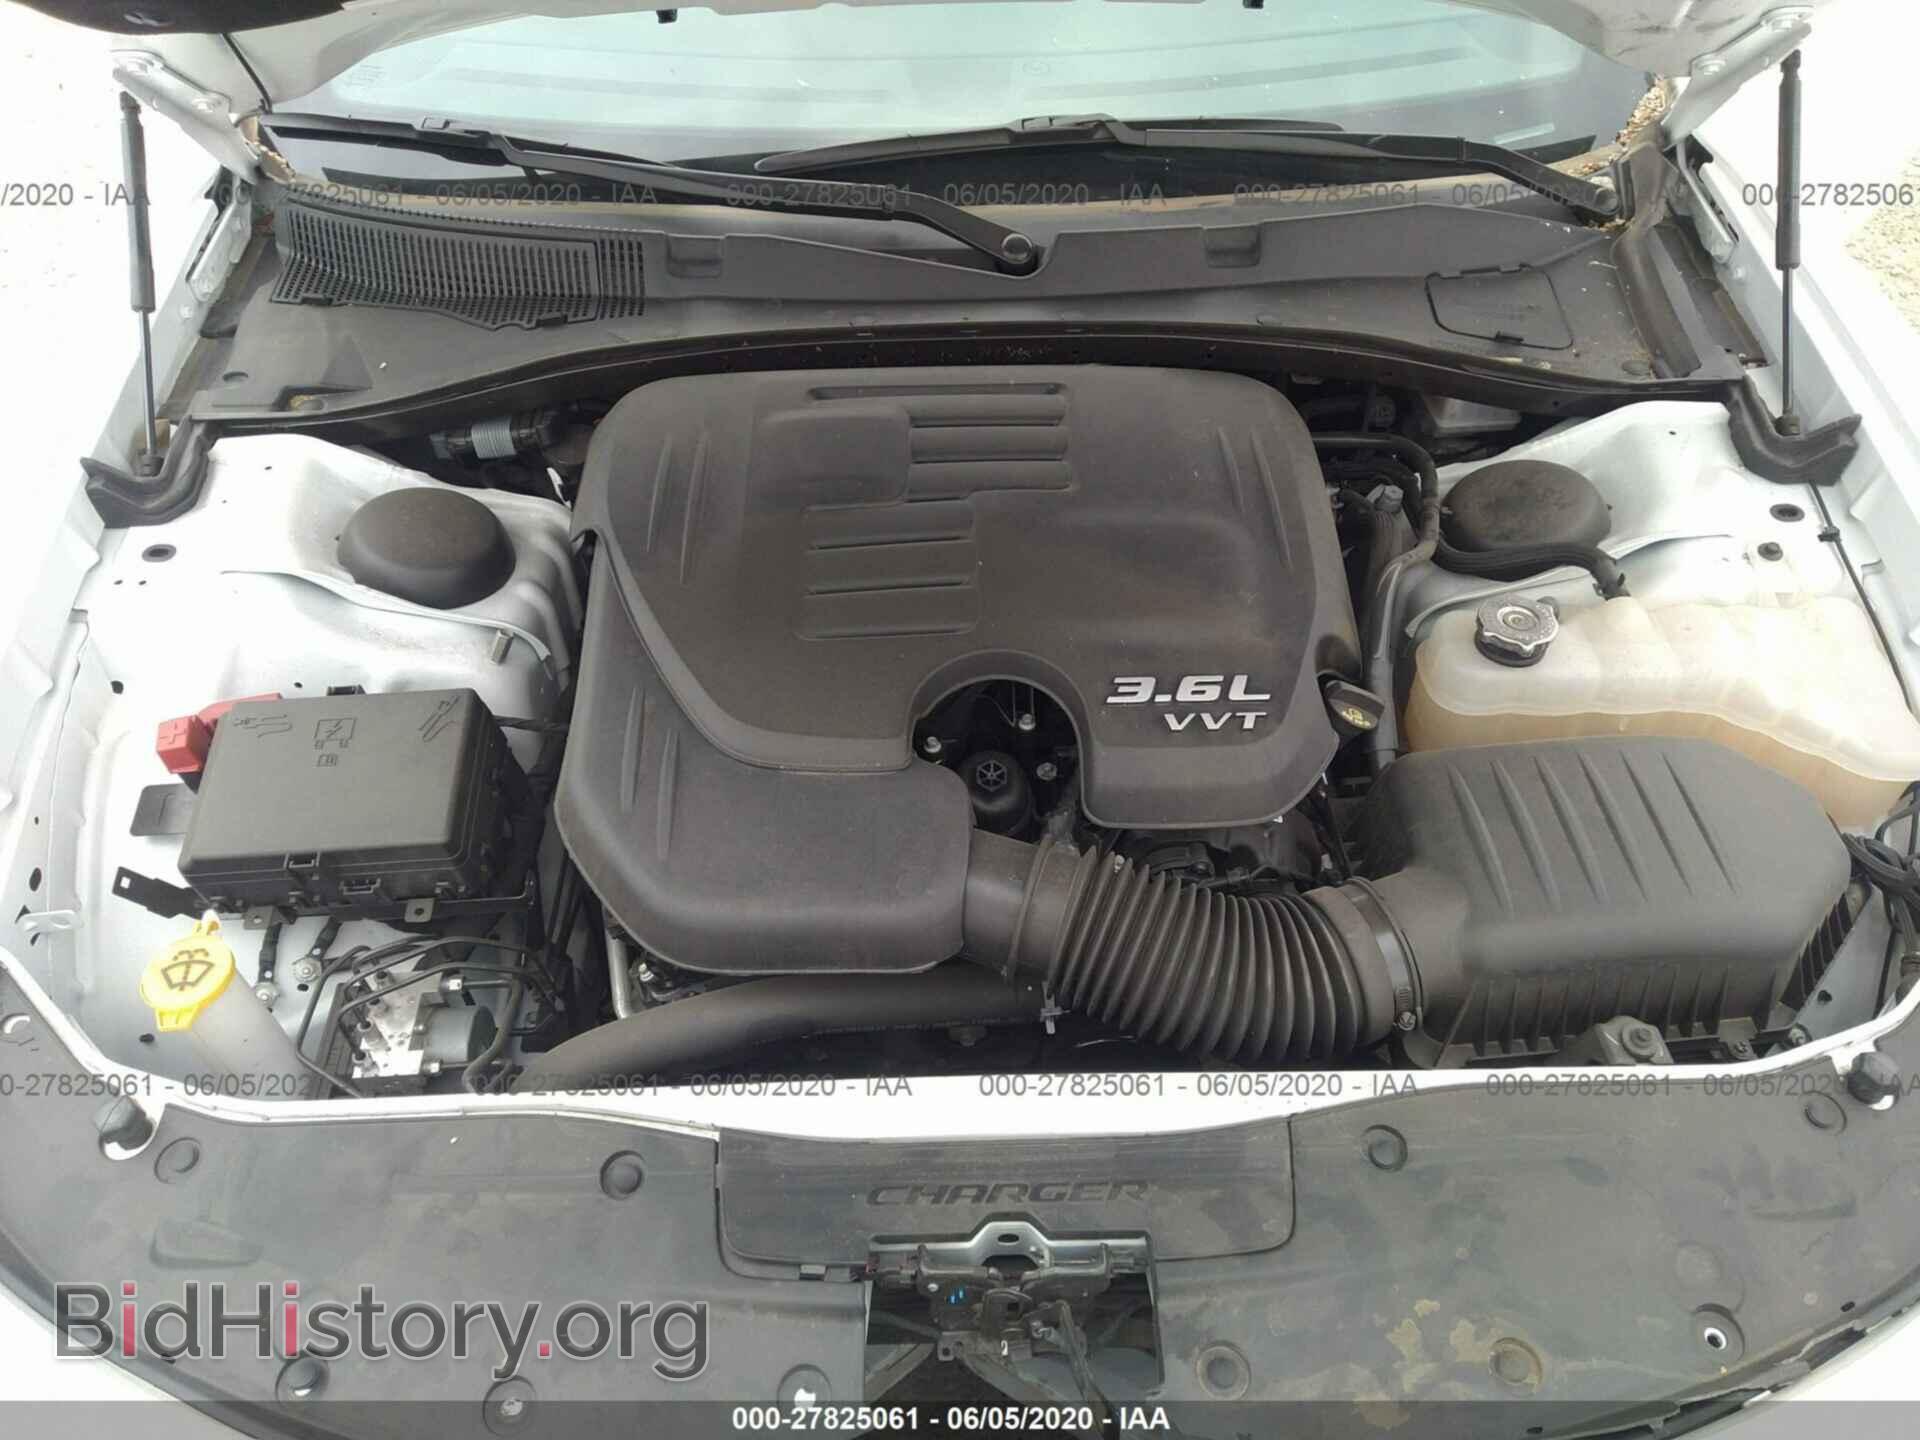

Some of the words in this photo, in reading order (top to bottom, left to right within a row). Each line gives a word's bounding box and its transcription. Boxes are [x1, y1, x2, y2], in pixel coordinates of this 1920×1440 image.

[1106, 674, 1272, 703] 3.6L
[1163, 711, 1268, 731] VVT
[866, 1180, 1149, 1206] CHARGER
